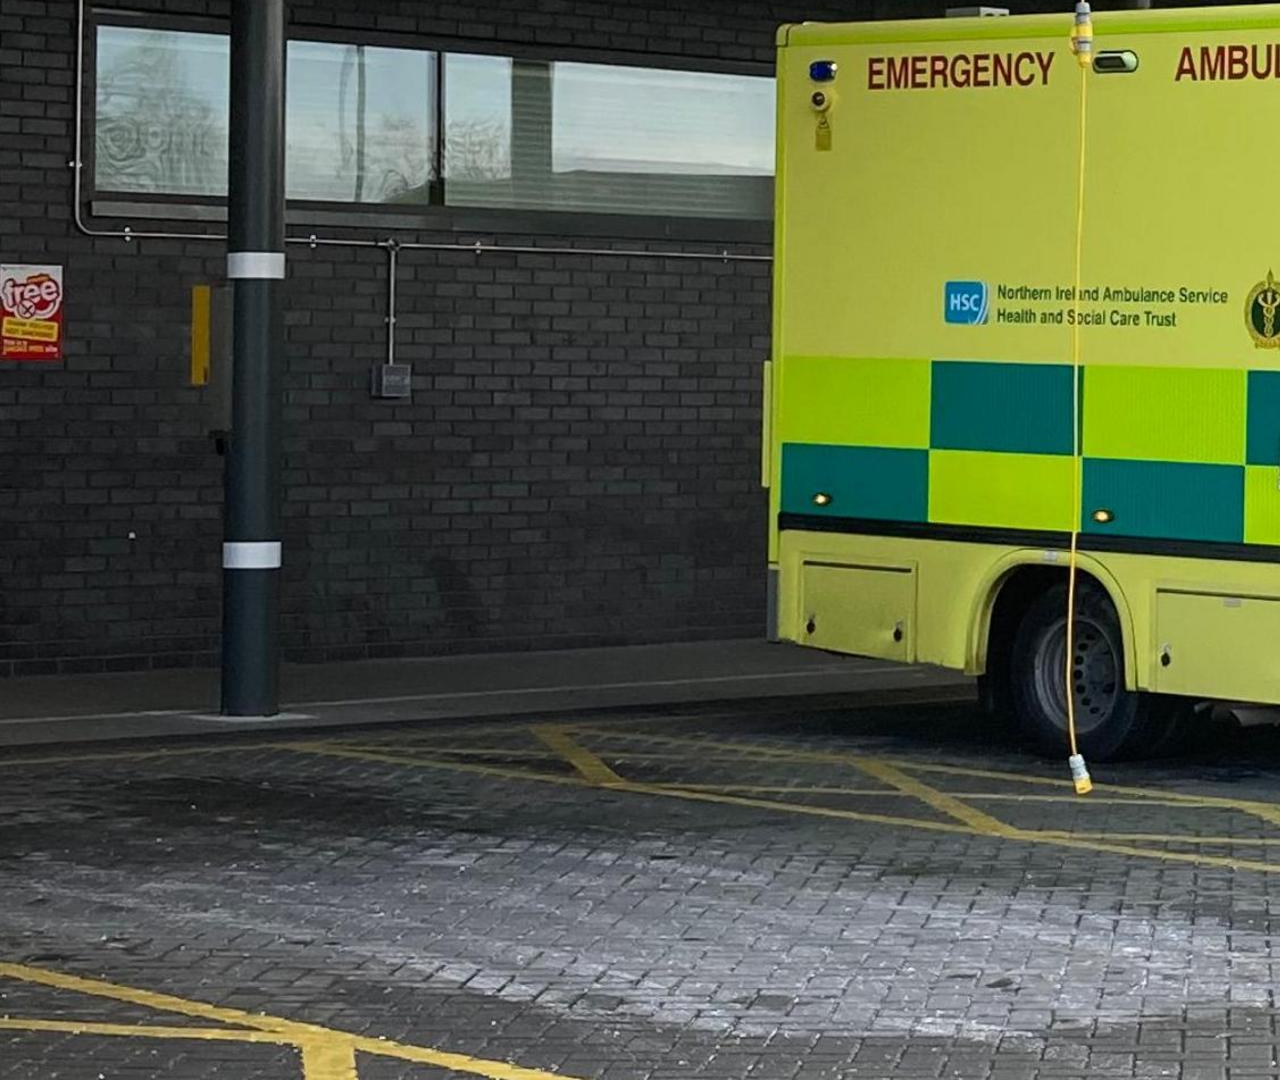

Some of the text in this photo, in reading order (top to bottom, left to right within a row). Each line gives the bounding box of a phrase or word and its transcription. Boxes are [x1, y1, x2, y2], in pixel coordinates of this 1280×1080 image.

[867, 52, 1055, 90] EMERGENCY
[3, 278, 59, 309] free
[950, 293, 980, 312] HSC
[997, 285, 1052, 300] Northern
[1103, 286, 1175, 303] Ambulance
[1179, 287, 1228, 303] Service
[997, 308, 1176, 327] Health and Social Care Trust
